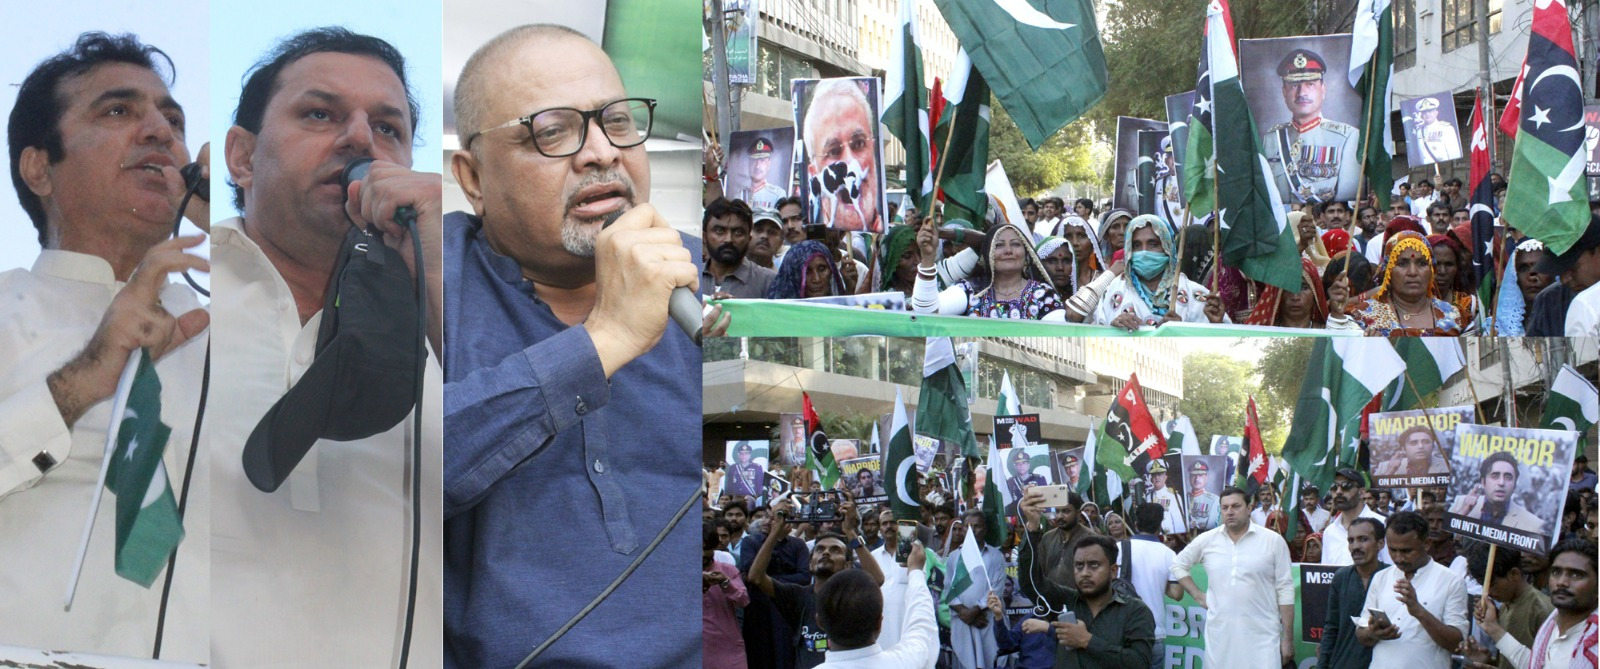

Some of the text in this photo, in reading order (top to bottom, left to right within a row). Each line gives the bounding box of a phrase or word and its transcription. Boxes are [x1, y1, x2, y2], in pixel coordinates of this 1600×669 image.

[1374, 413, 1461, 435] WARRIOR
[1460, 433, 1555, 467] WARRIOR
[1378, 478, 1389, 486] ON
[1390, 477, 1409, 486] INT'L
[1411, 476, 1436, 485] MEDIA
[1450, 518, 1540, 550] ON INT'L MEDIA FRONT
